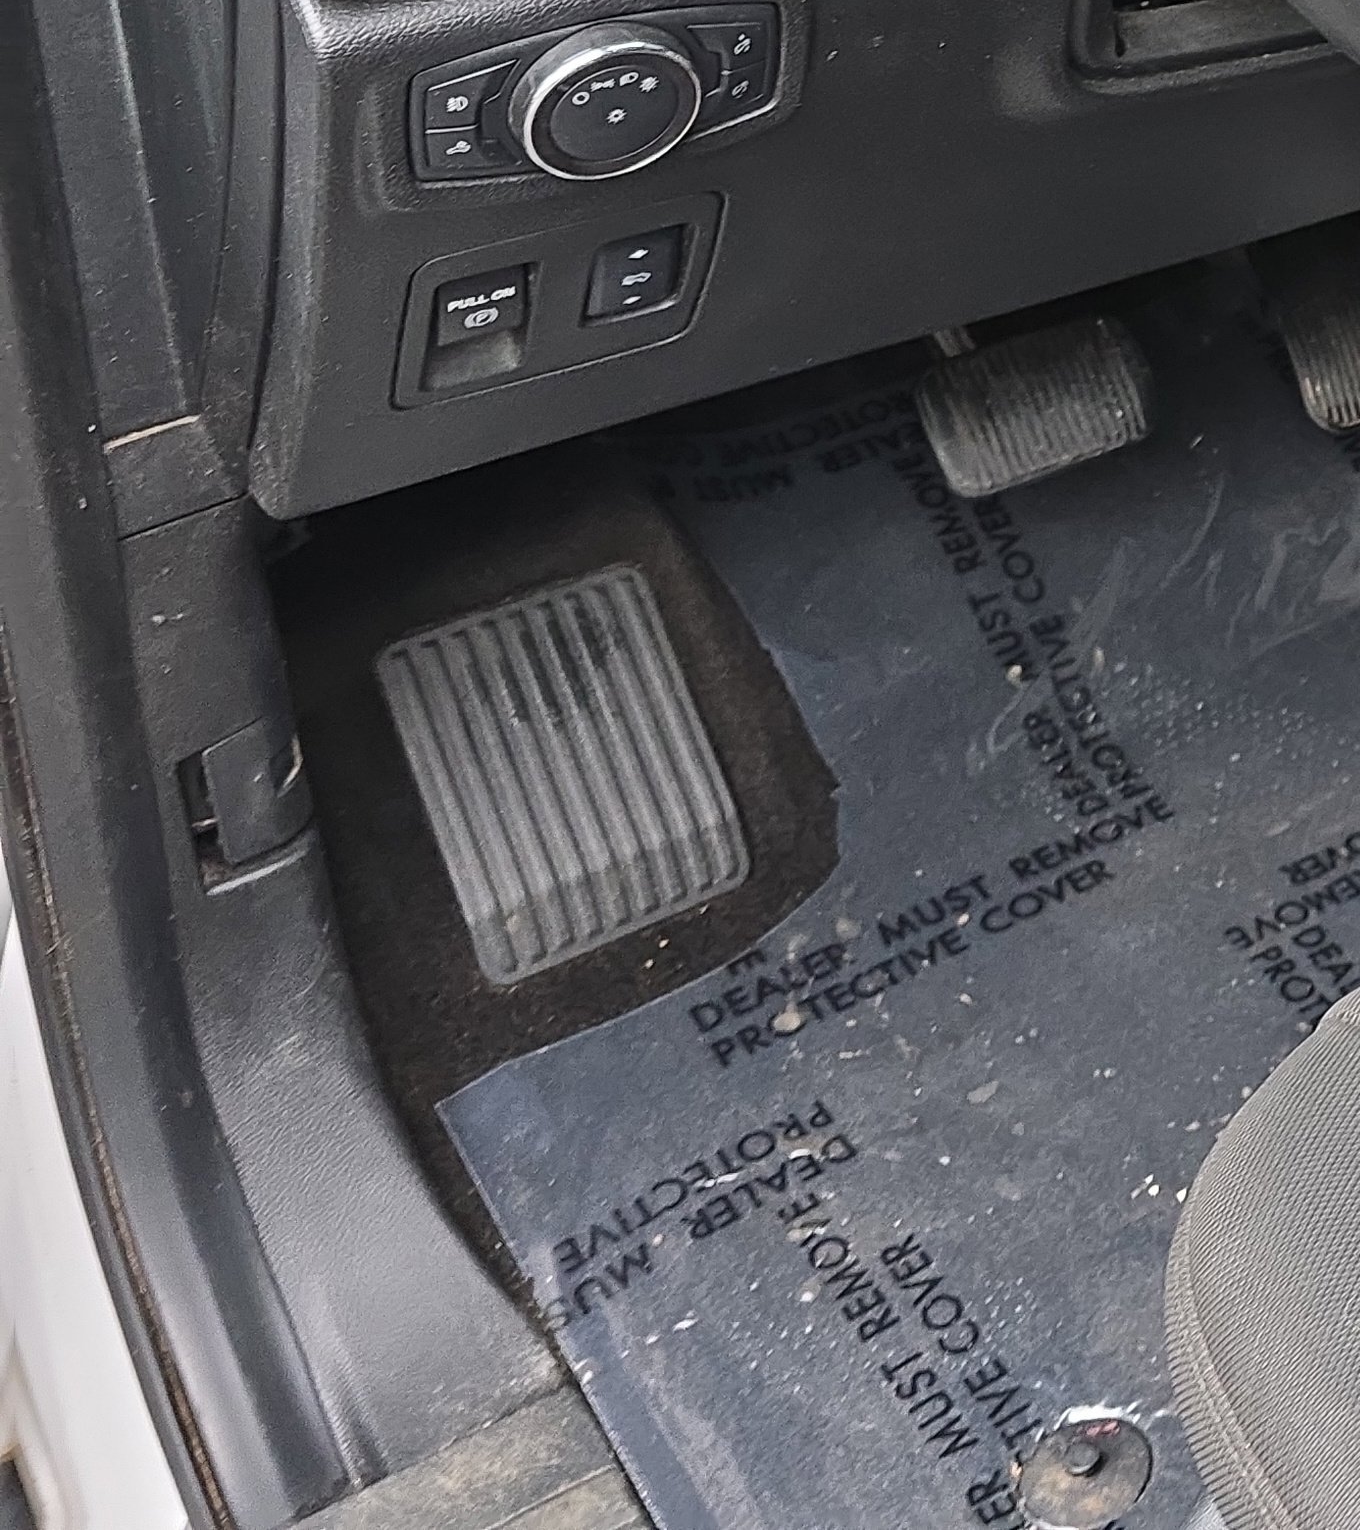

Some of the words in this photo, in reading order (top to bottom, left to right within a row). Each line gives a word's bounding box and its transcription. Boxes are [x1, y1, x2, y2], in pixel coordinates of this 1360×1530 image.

[447, 293, 489, 313] PULL
[489, 286, 516, 302] ON
[967, 589, 1043, 684] MUST
[1021, 710, 1109, 818] DEALER
[687, 941, 851, 1034] DEALER
[876, 874, 992, 948] MUST
[1007, 792, 1175, 880] REMOVE
[979, 858, 1117, 936] COVER
[552, 1100, 834, 1273] PROTECTIVE
[681, 1133, 859, 1241] DEALER
[880, 1231, 980, 1357] COVER
[880, 1351, 979, 1460] MUST
